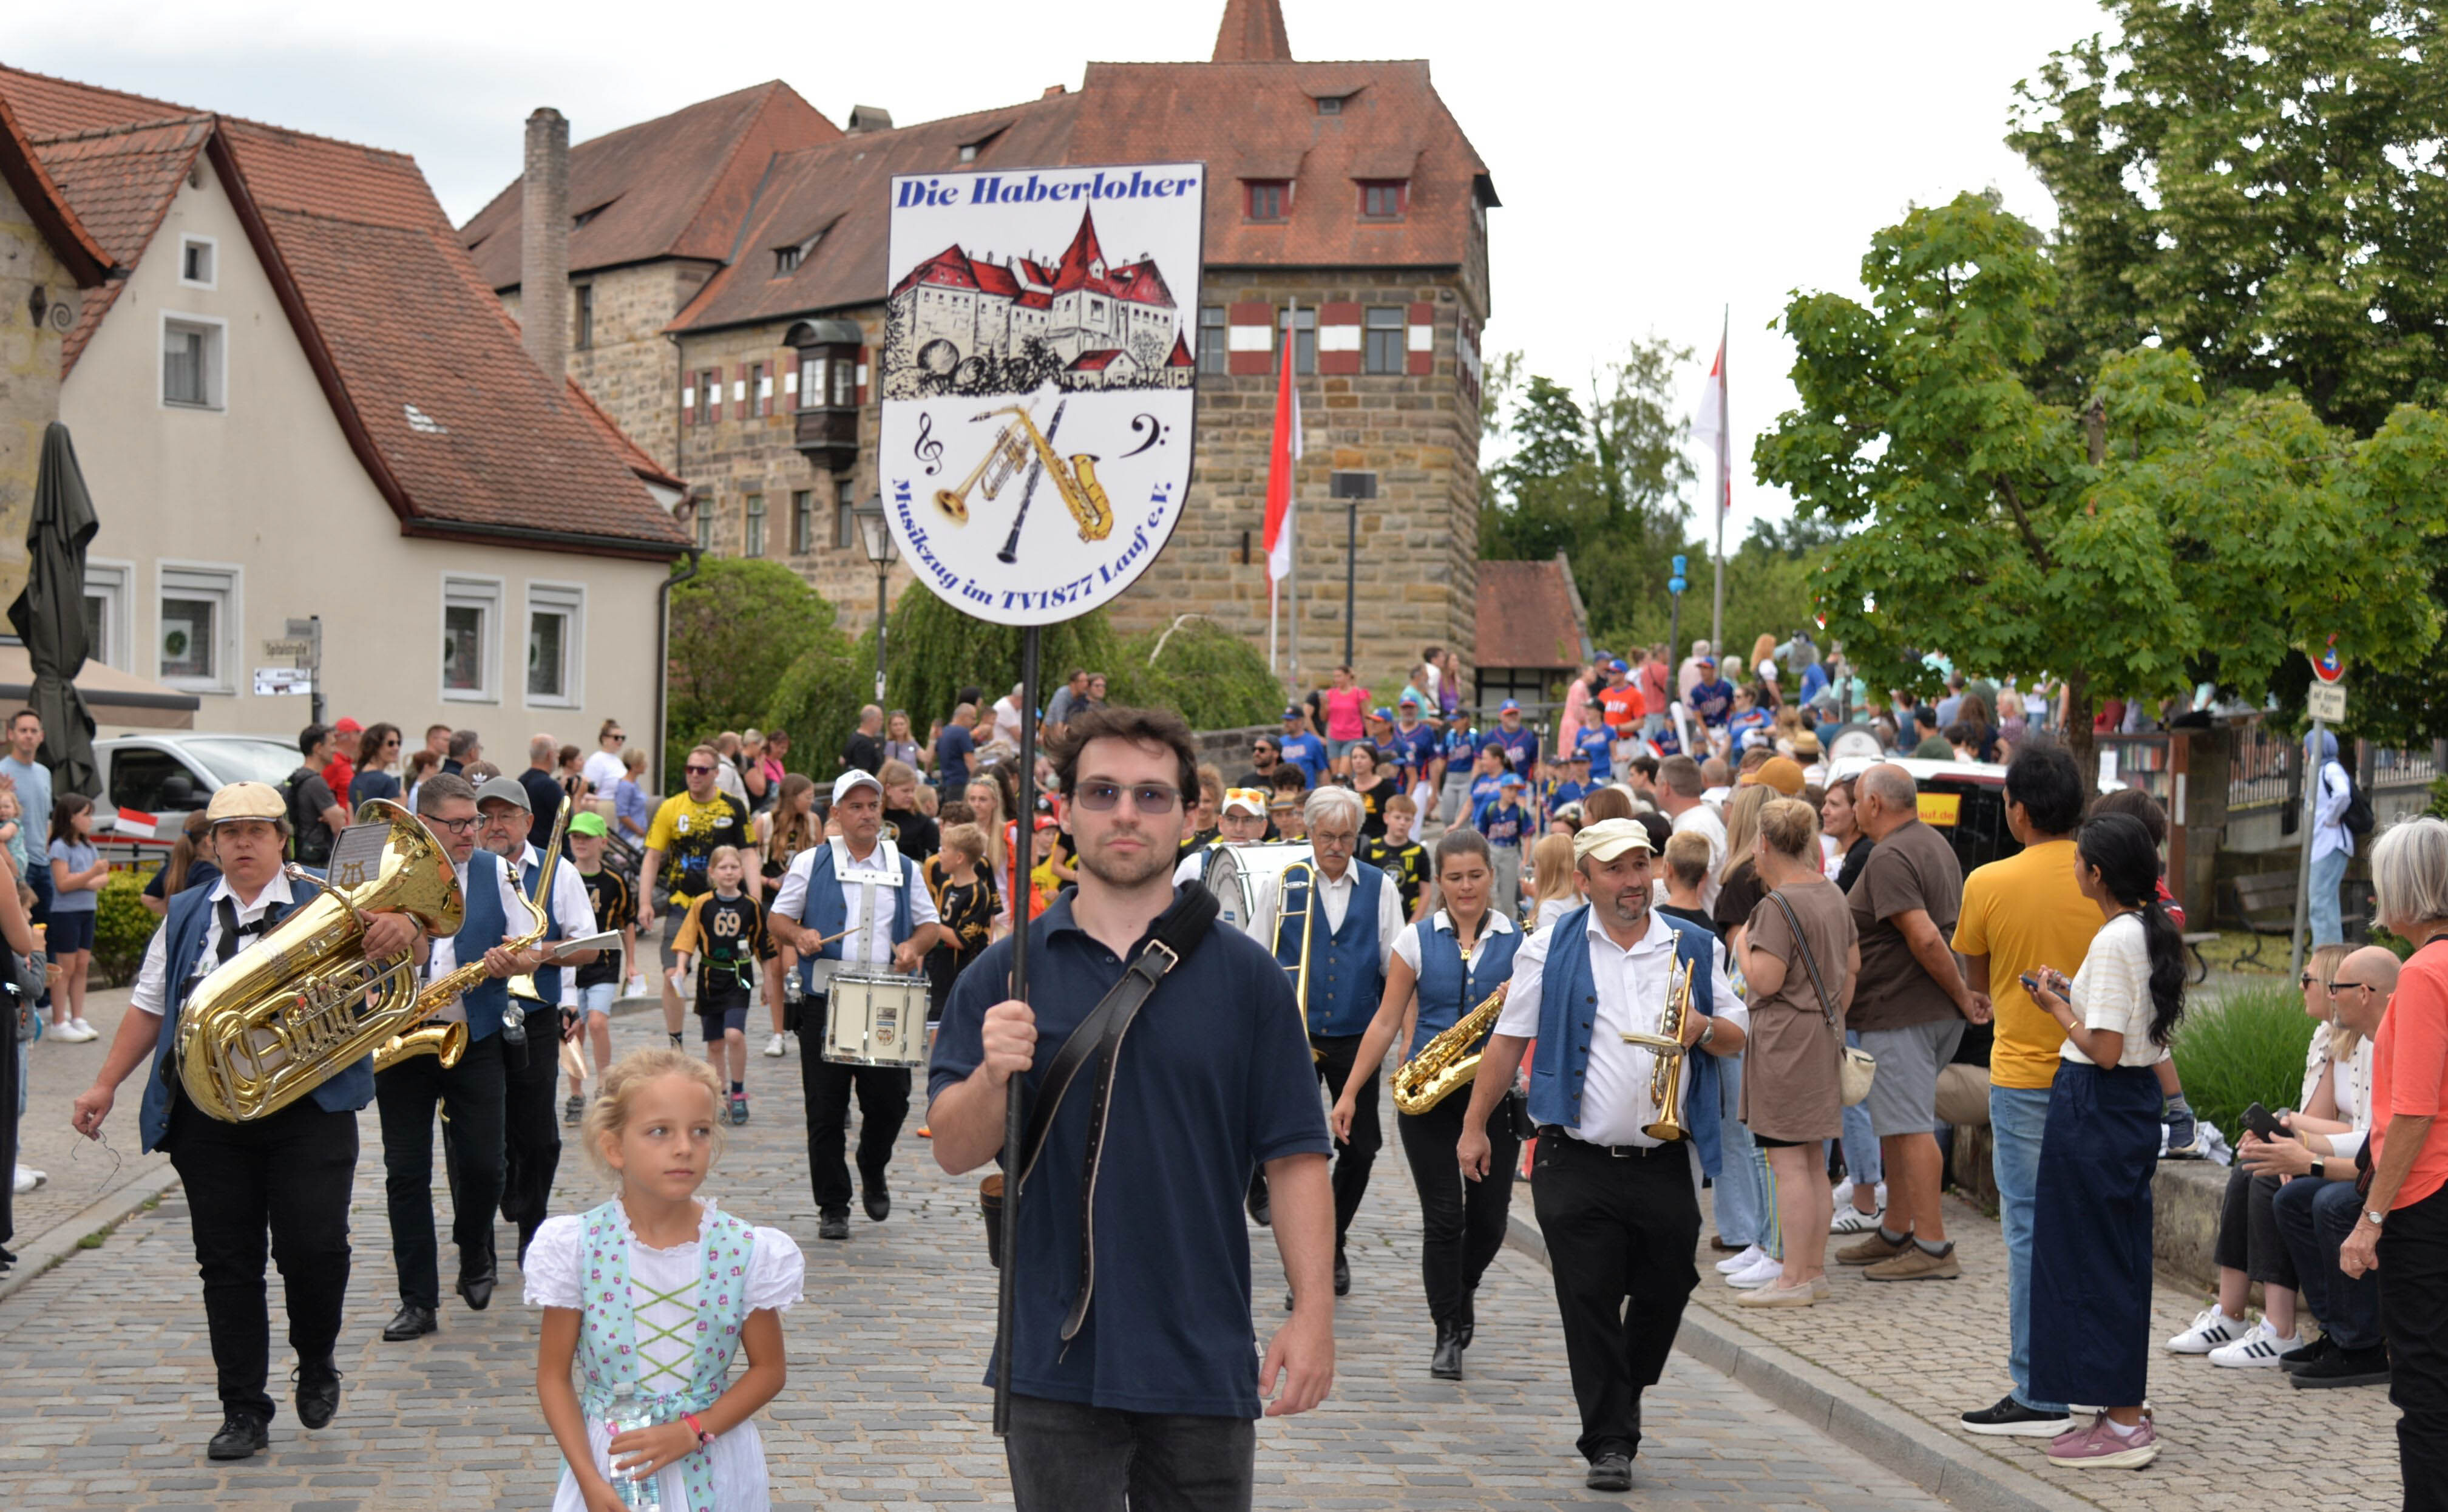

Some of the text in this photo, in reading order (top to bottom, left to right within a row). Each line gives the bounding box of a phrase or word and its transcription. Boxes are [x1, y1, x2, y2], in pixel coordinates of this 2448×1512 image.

[895, 170, 1196, 208] Die Haberloher
[892, 478, 960, 590] Musikzug
[961, 578, 994, 606] im
[1098, 525, 1149, 586] Lauf
[1147, 481, 1173, 529] e.V.
[678, 814, 690, 832] C
[941, 897, 956, 921] 5
[714, 912, 741, 937] 69
